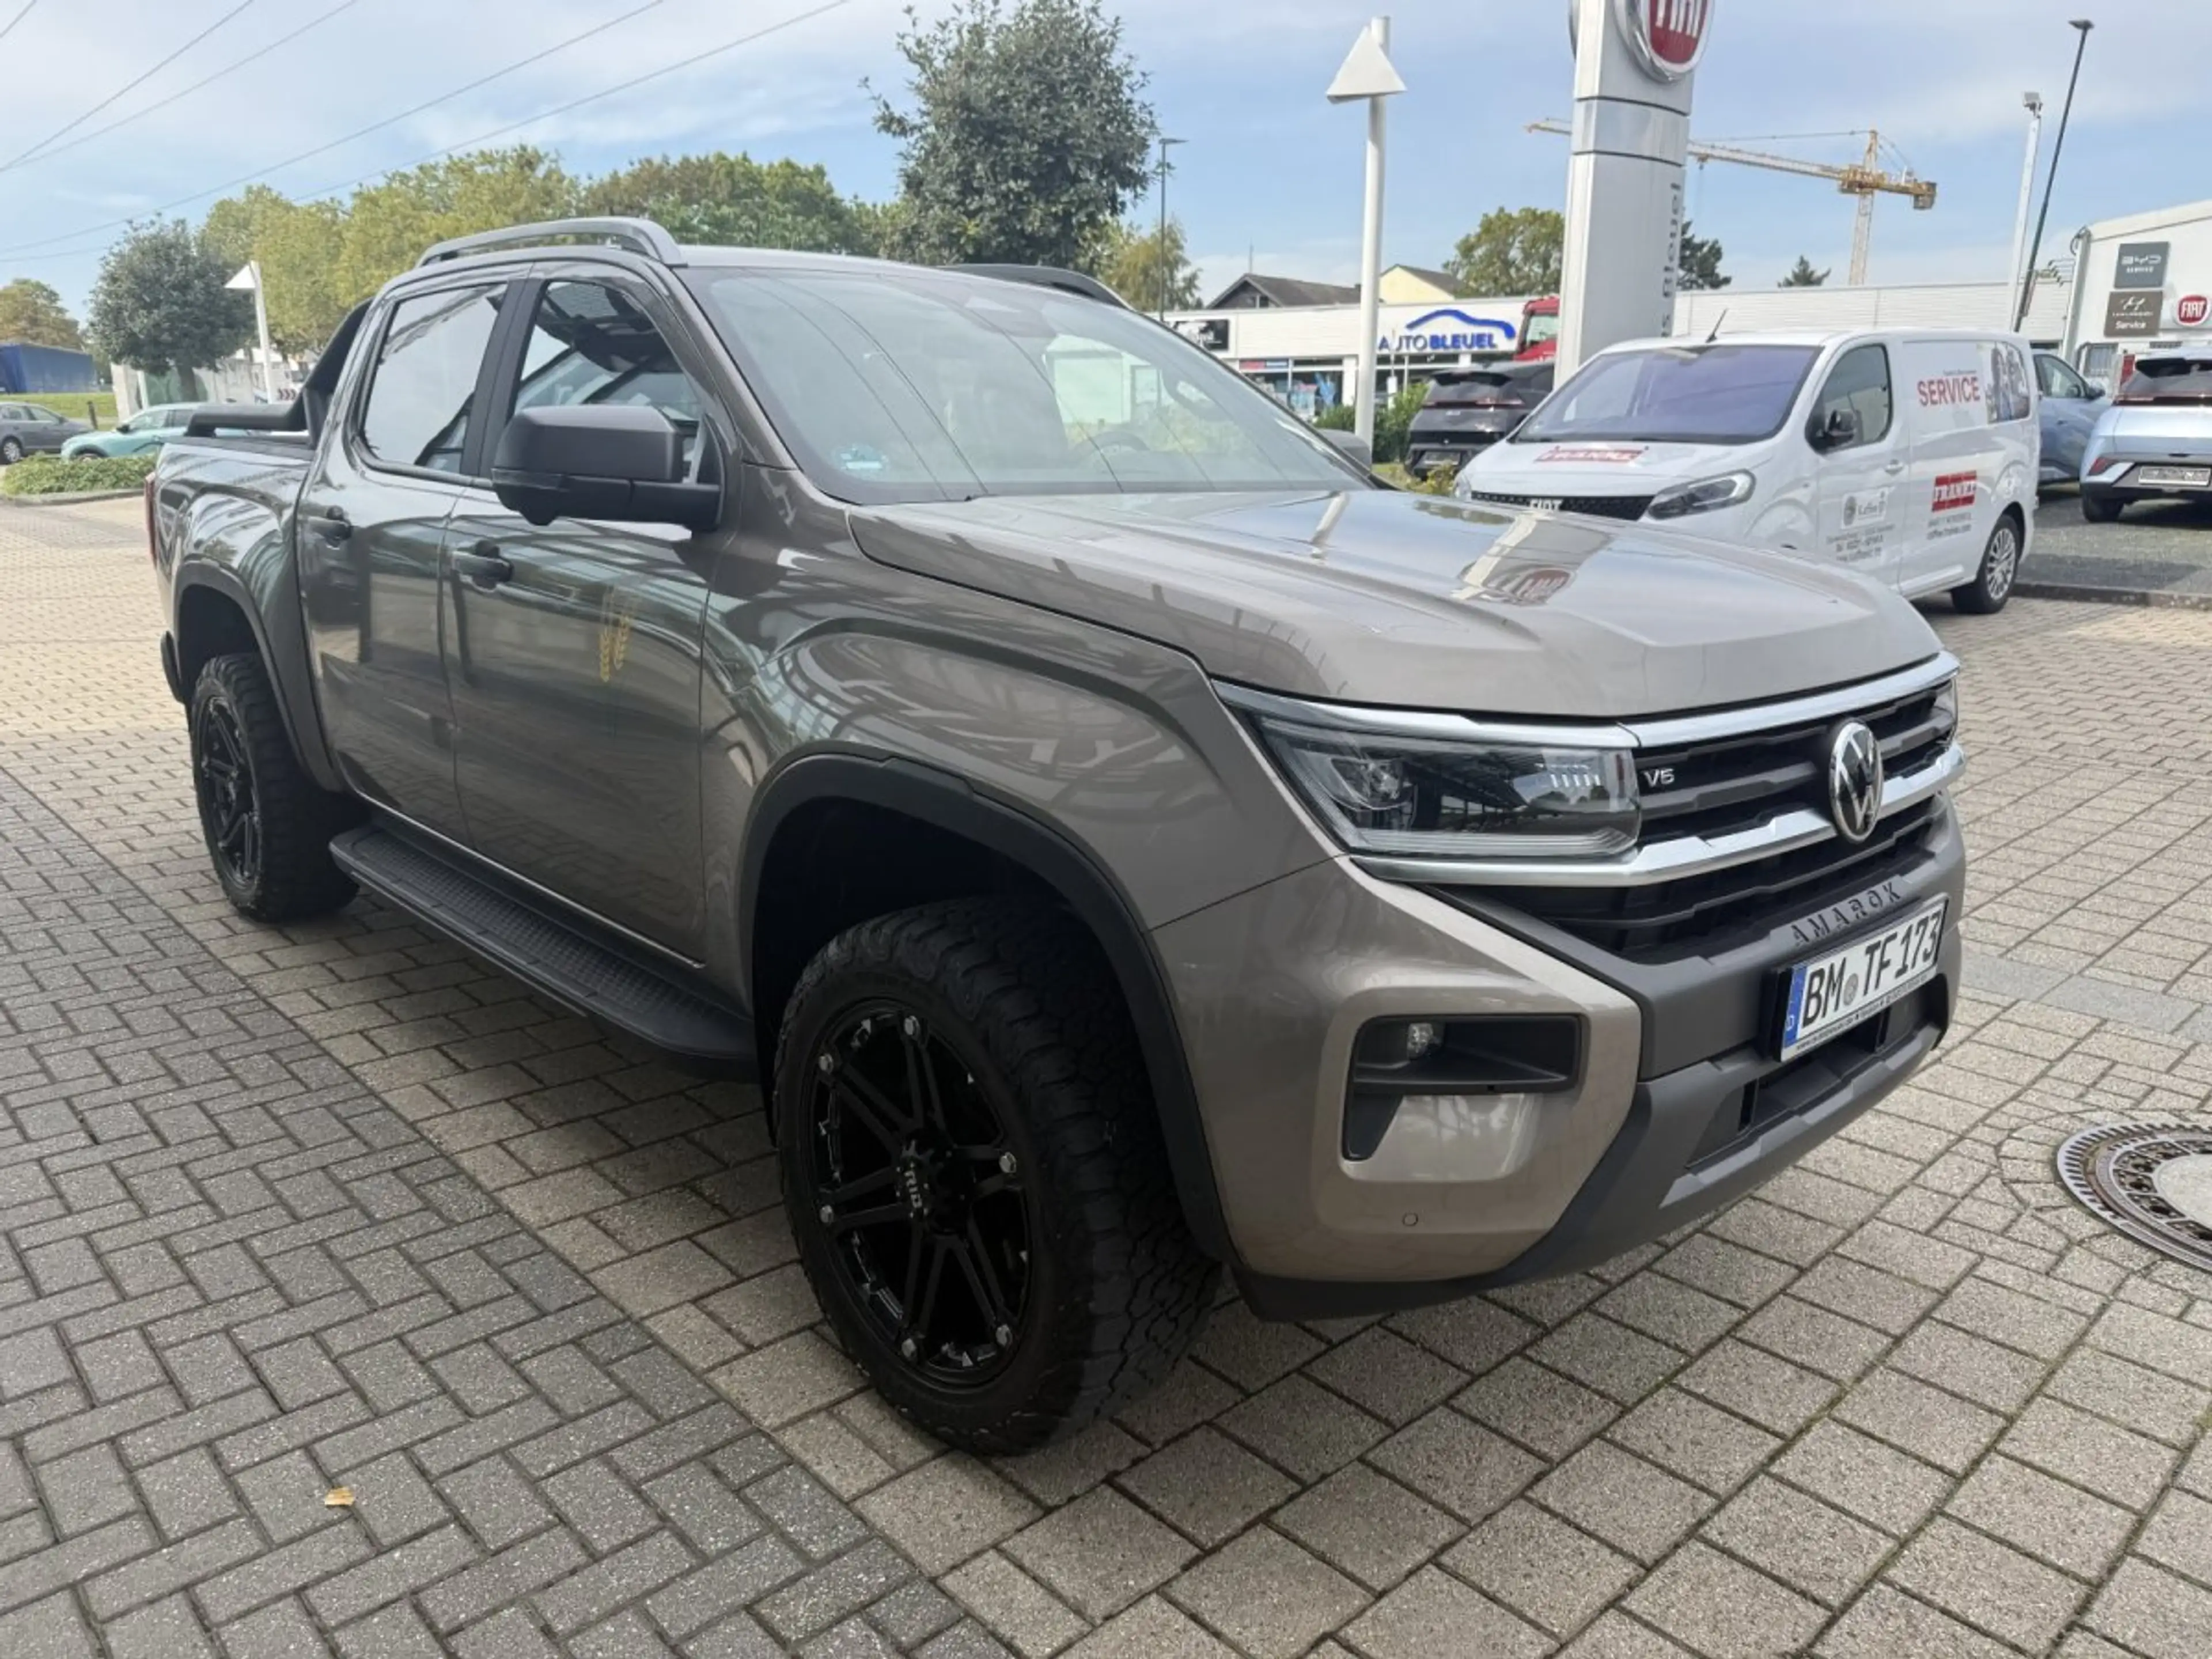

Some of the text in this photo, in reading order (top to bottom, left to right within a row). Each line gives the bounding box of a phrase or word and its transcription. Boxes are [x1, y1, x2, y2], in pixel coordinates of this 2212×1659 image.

[2181, 301, 2206, 319] FIAT
[1917, 377, 1980, 407] SERVICE
[1791, 882, 1900, 946] AMAROK
[1802, 957, 1846, 1028] BM
